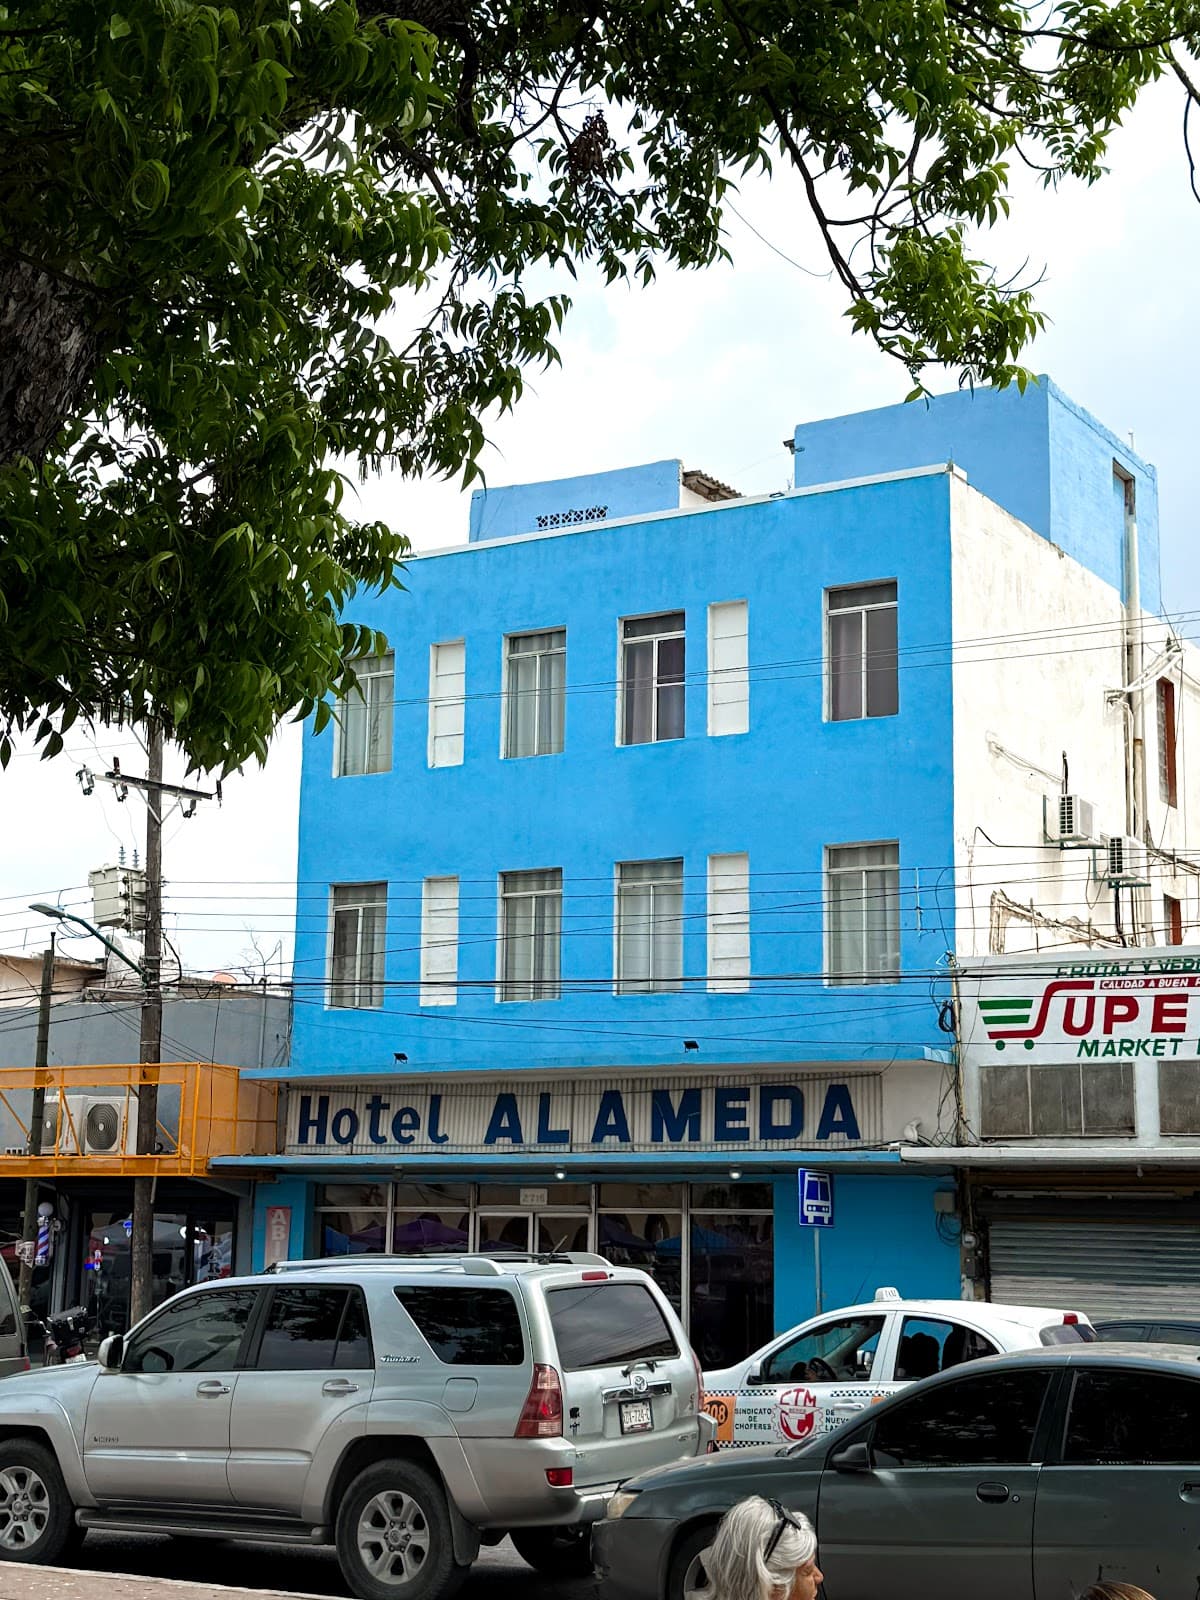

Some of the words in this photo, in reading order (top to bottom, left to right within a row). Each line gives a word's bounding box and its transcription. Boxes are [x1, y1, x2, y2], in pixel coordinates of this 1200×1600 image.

[1101, 979, 1145, 989] CALIDAD
[1148, 980, 1155, 988] A
[1158, 978, 1189, 988] BUEN
[1077, 1038, 1183, 1058] MARKET
[298, 1094, 449, 1145] Hotel
[483, 1083, 861, 1144] ALAMEDA
